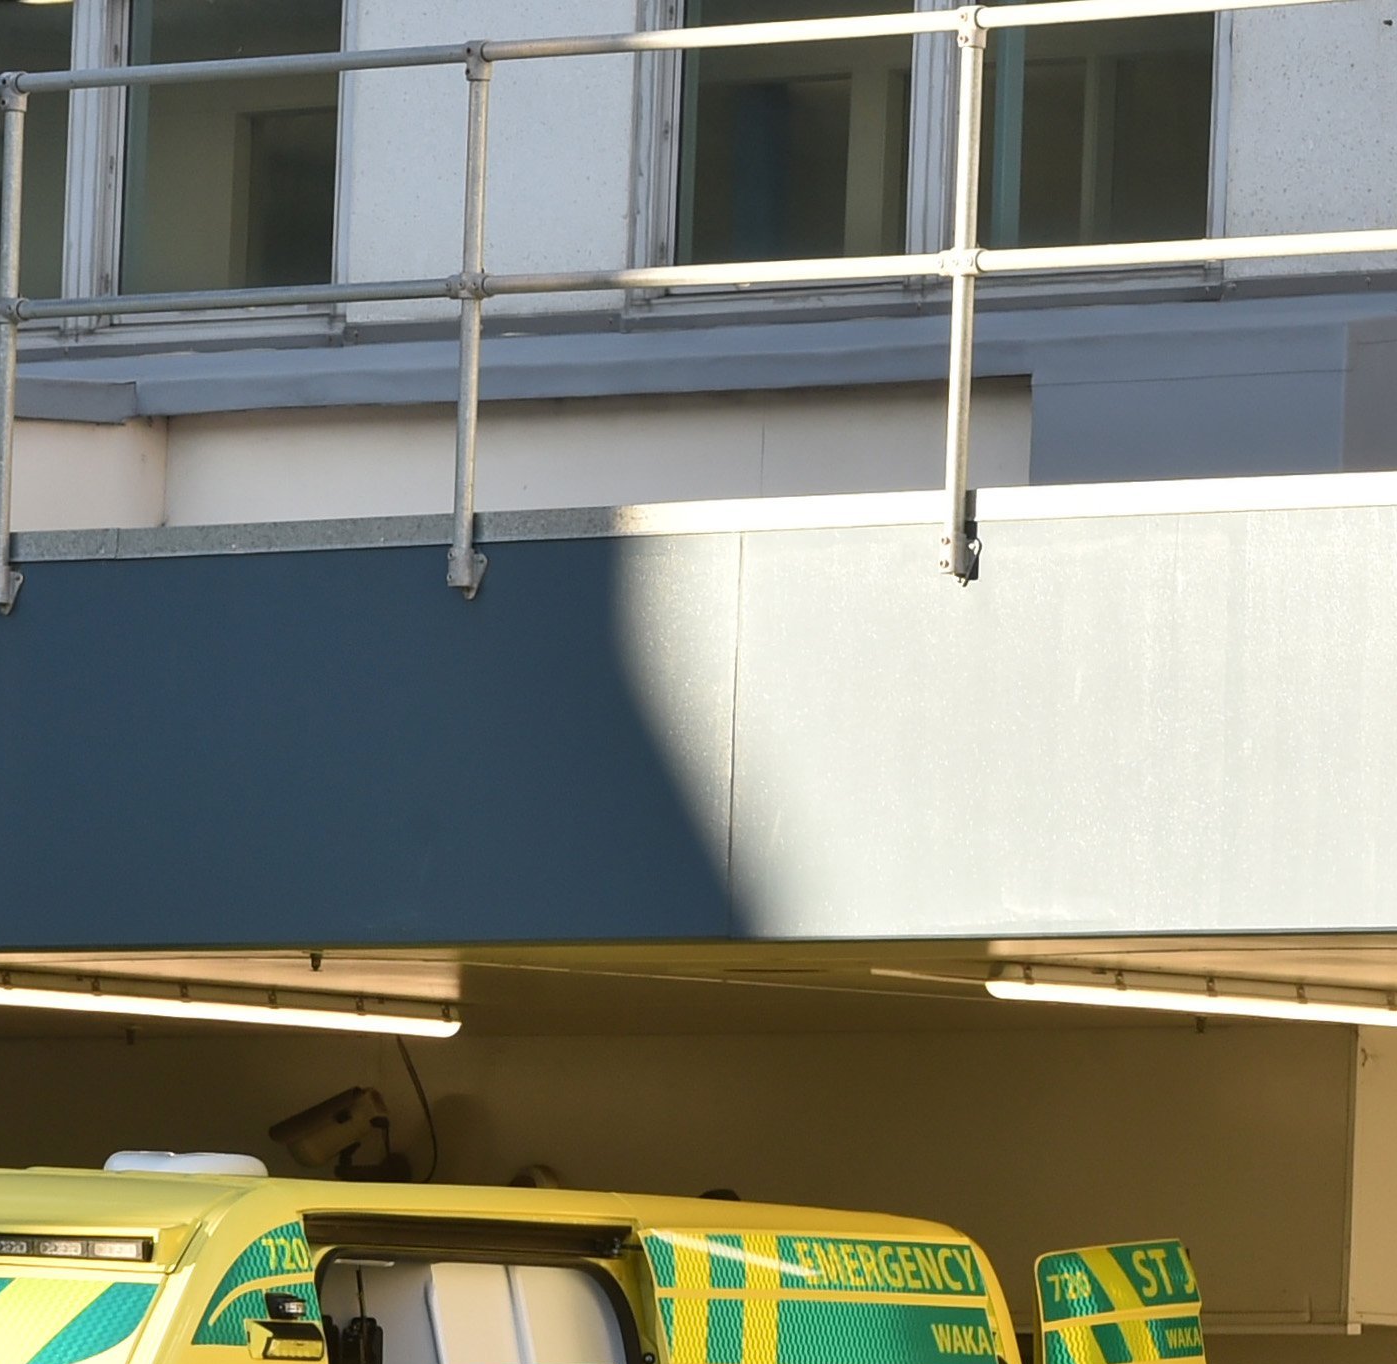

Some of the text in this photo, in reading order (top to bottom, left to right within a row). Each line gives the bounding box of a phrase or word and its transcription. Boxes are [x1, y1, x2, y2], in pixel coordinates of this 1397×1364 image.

[261, 1238, 309, 1270] 720
[794, 1241, 976, 1291] EMERGENCY
[1132, 1249, 1173, 1297] ST
[931, 1323, 993, 1356] WAKA
[1164, 1327, 1202, 1349] WAKA
